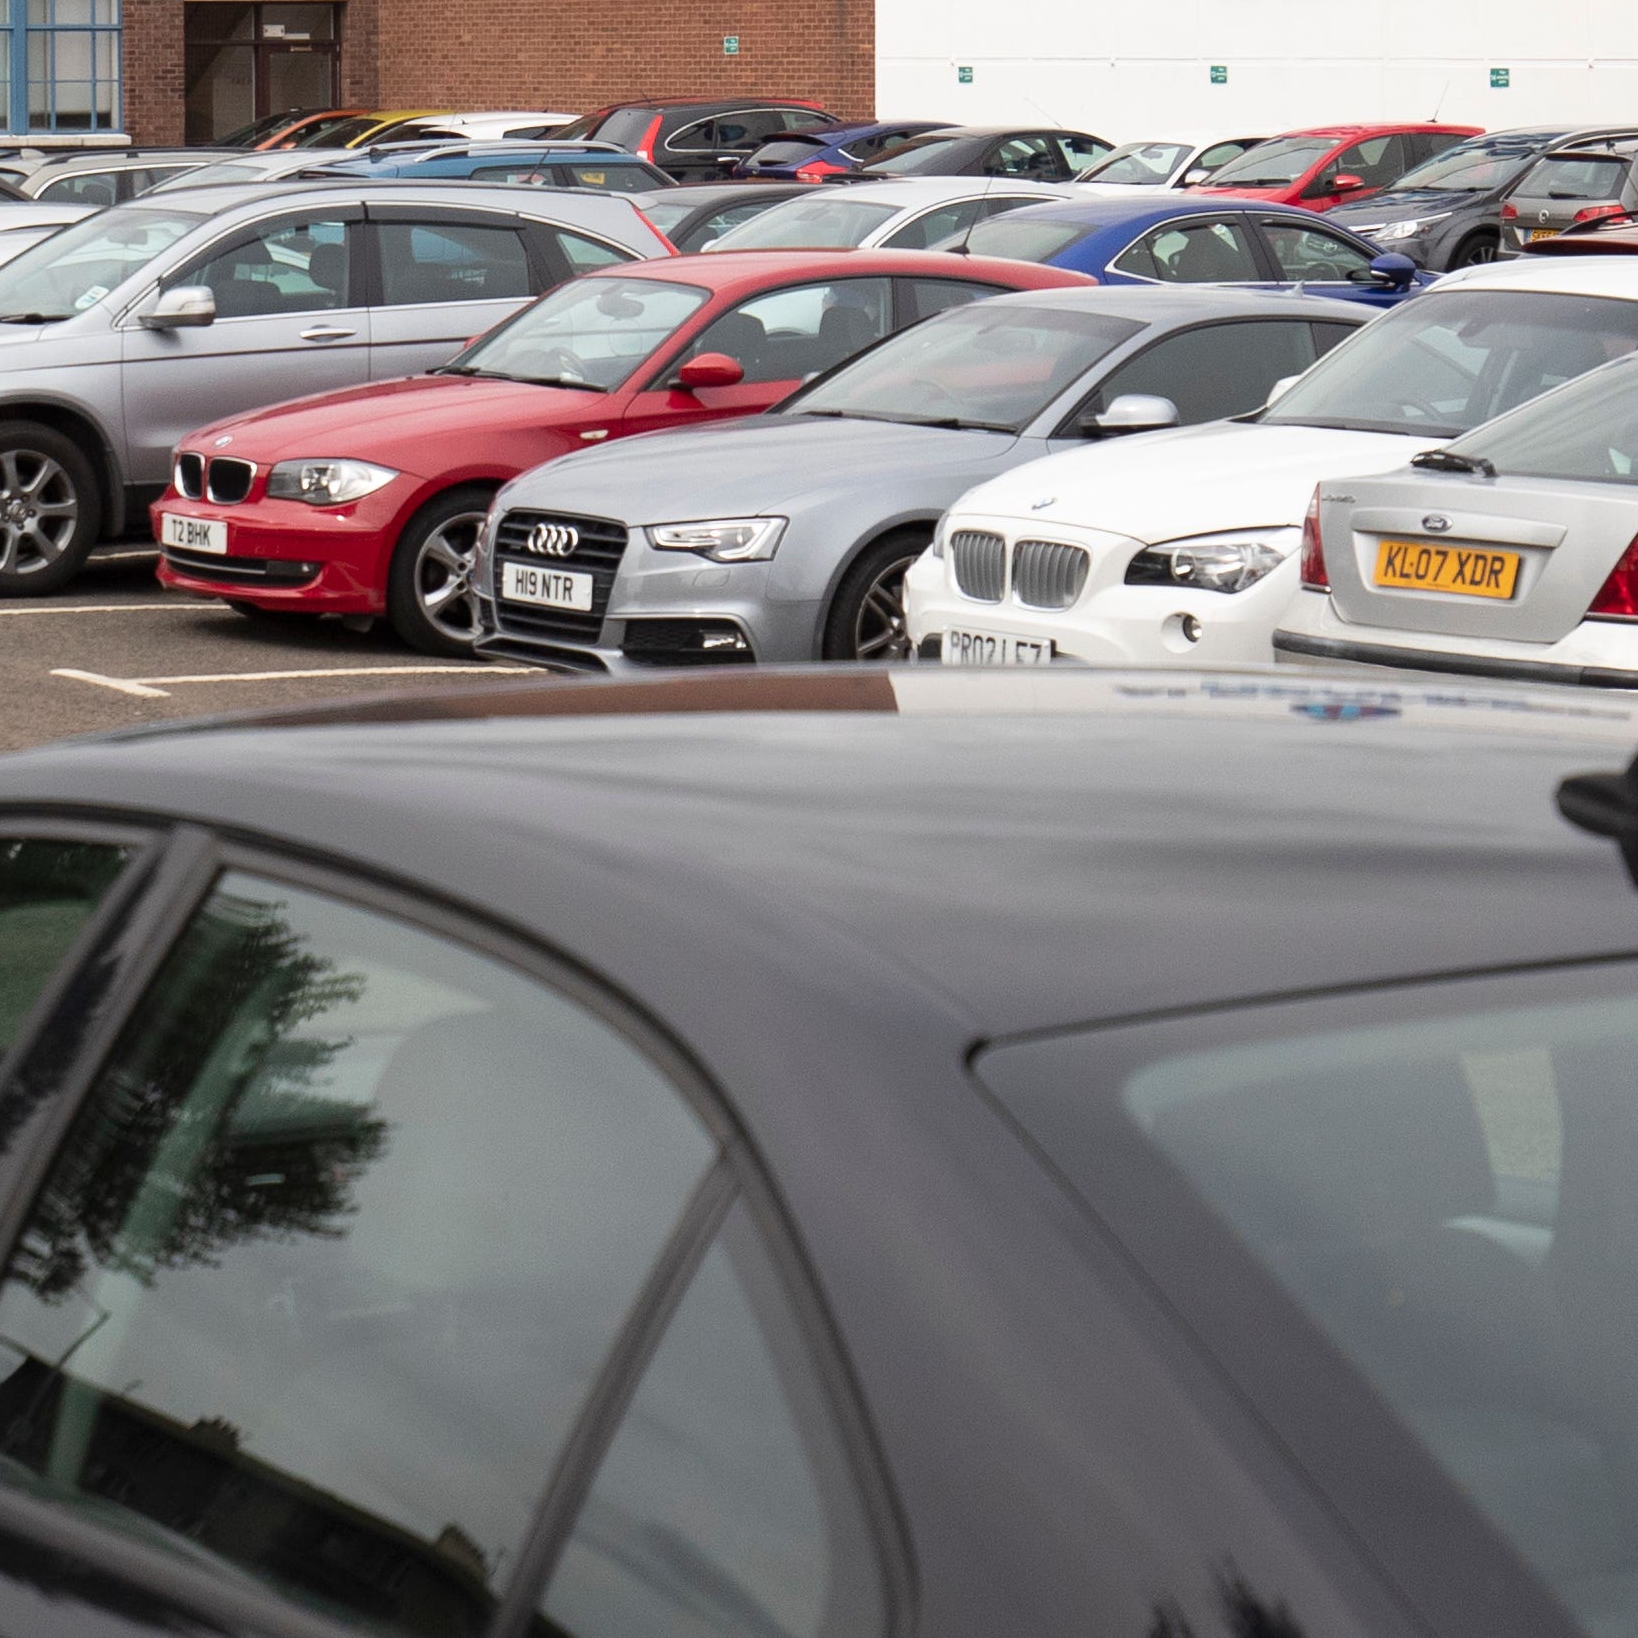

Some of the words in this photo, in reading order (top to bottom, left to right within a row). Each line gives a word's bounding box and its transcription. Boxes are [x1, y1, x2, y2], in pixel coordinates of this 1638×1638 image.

[172, 518, 184, 543] T2
[187, 522, 211, 548] BHK
[1383, 544, 1450, 583] KL07
[1452, 551, 1505, 589] XDR
[541, 572, 574, 602] NTR
